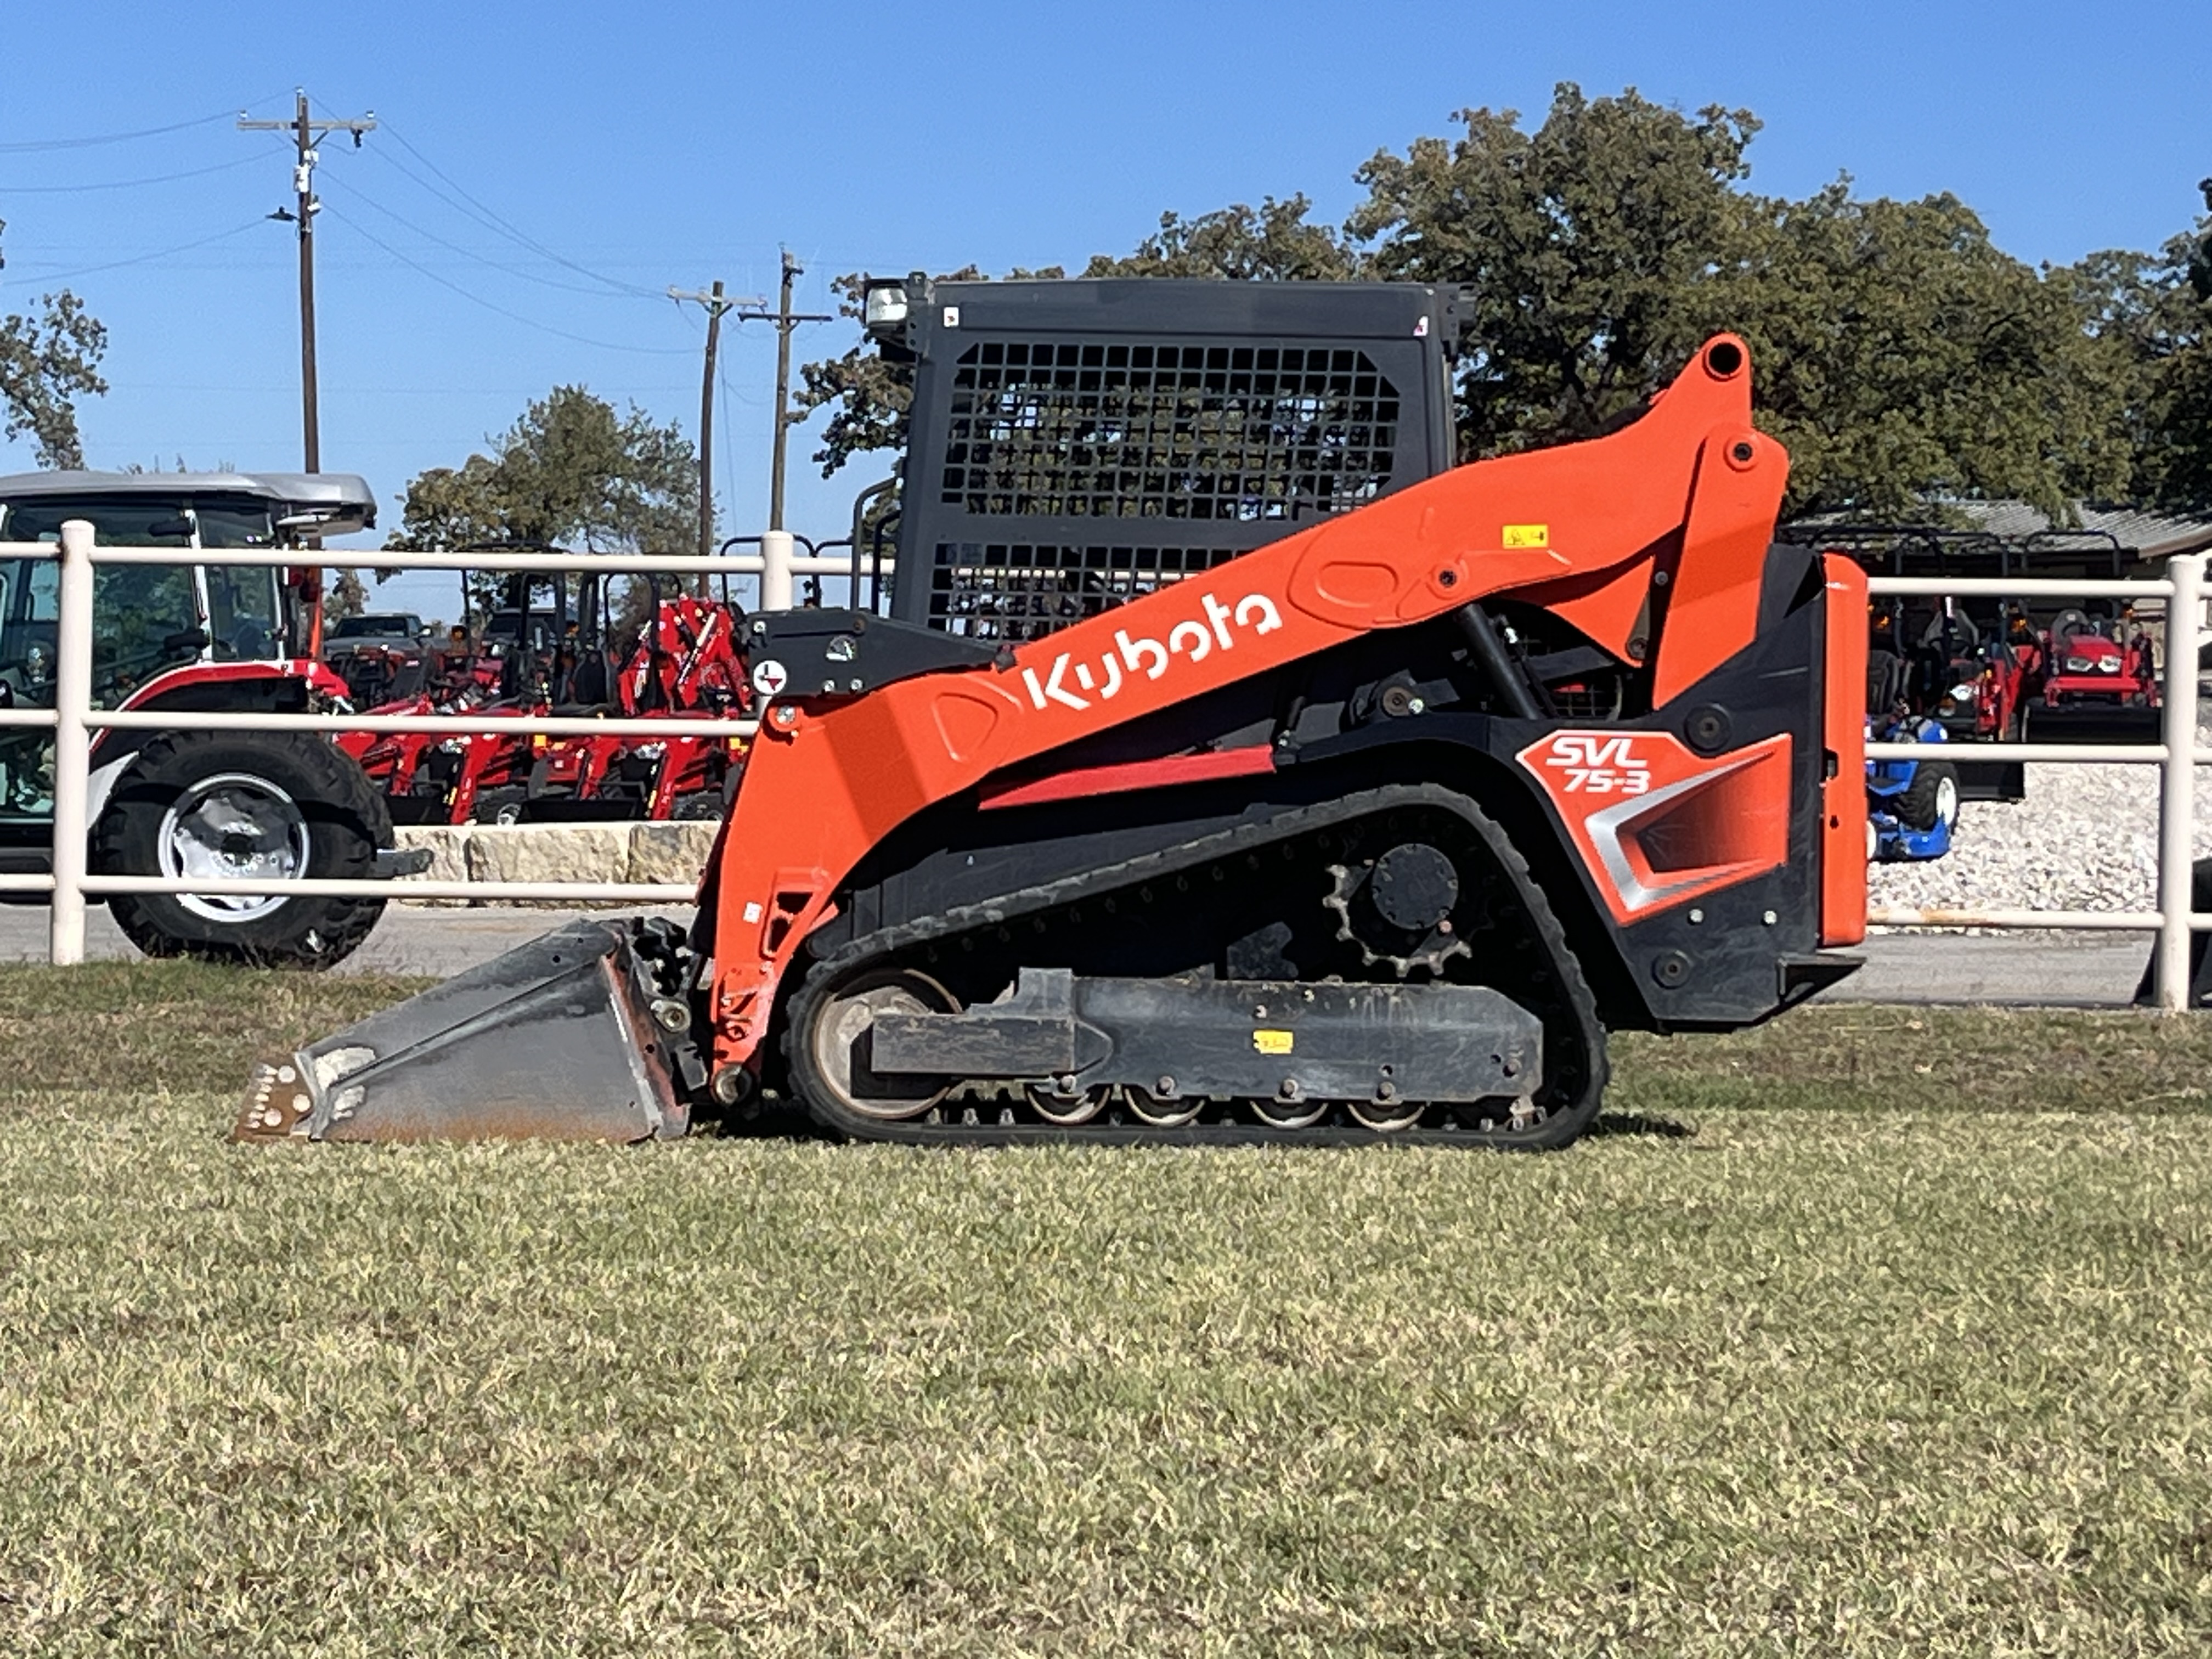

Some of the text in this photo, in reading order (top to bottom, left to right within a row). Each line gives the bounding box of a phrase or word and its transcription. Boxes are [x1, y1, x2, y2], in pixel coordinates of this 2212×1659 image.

[1022, 592, 1283, 711] Kubota
[1545, 737, 1648, 767] SVL
[1562, 769, 1651, 793] 75-3
